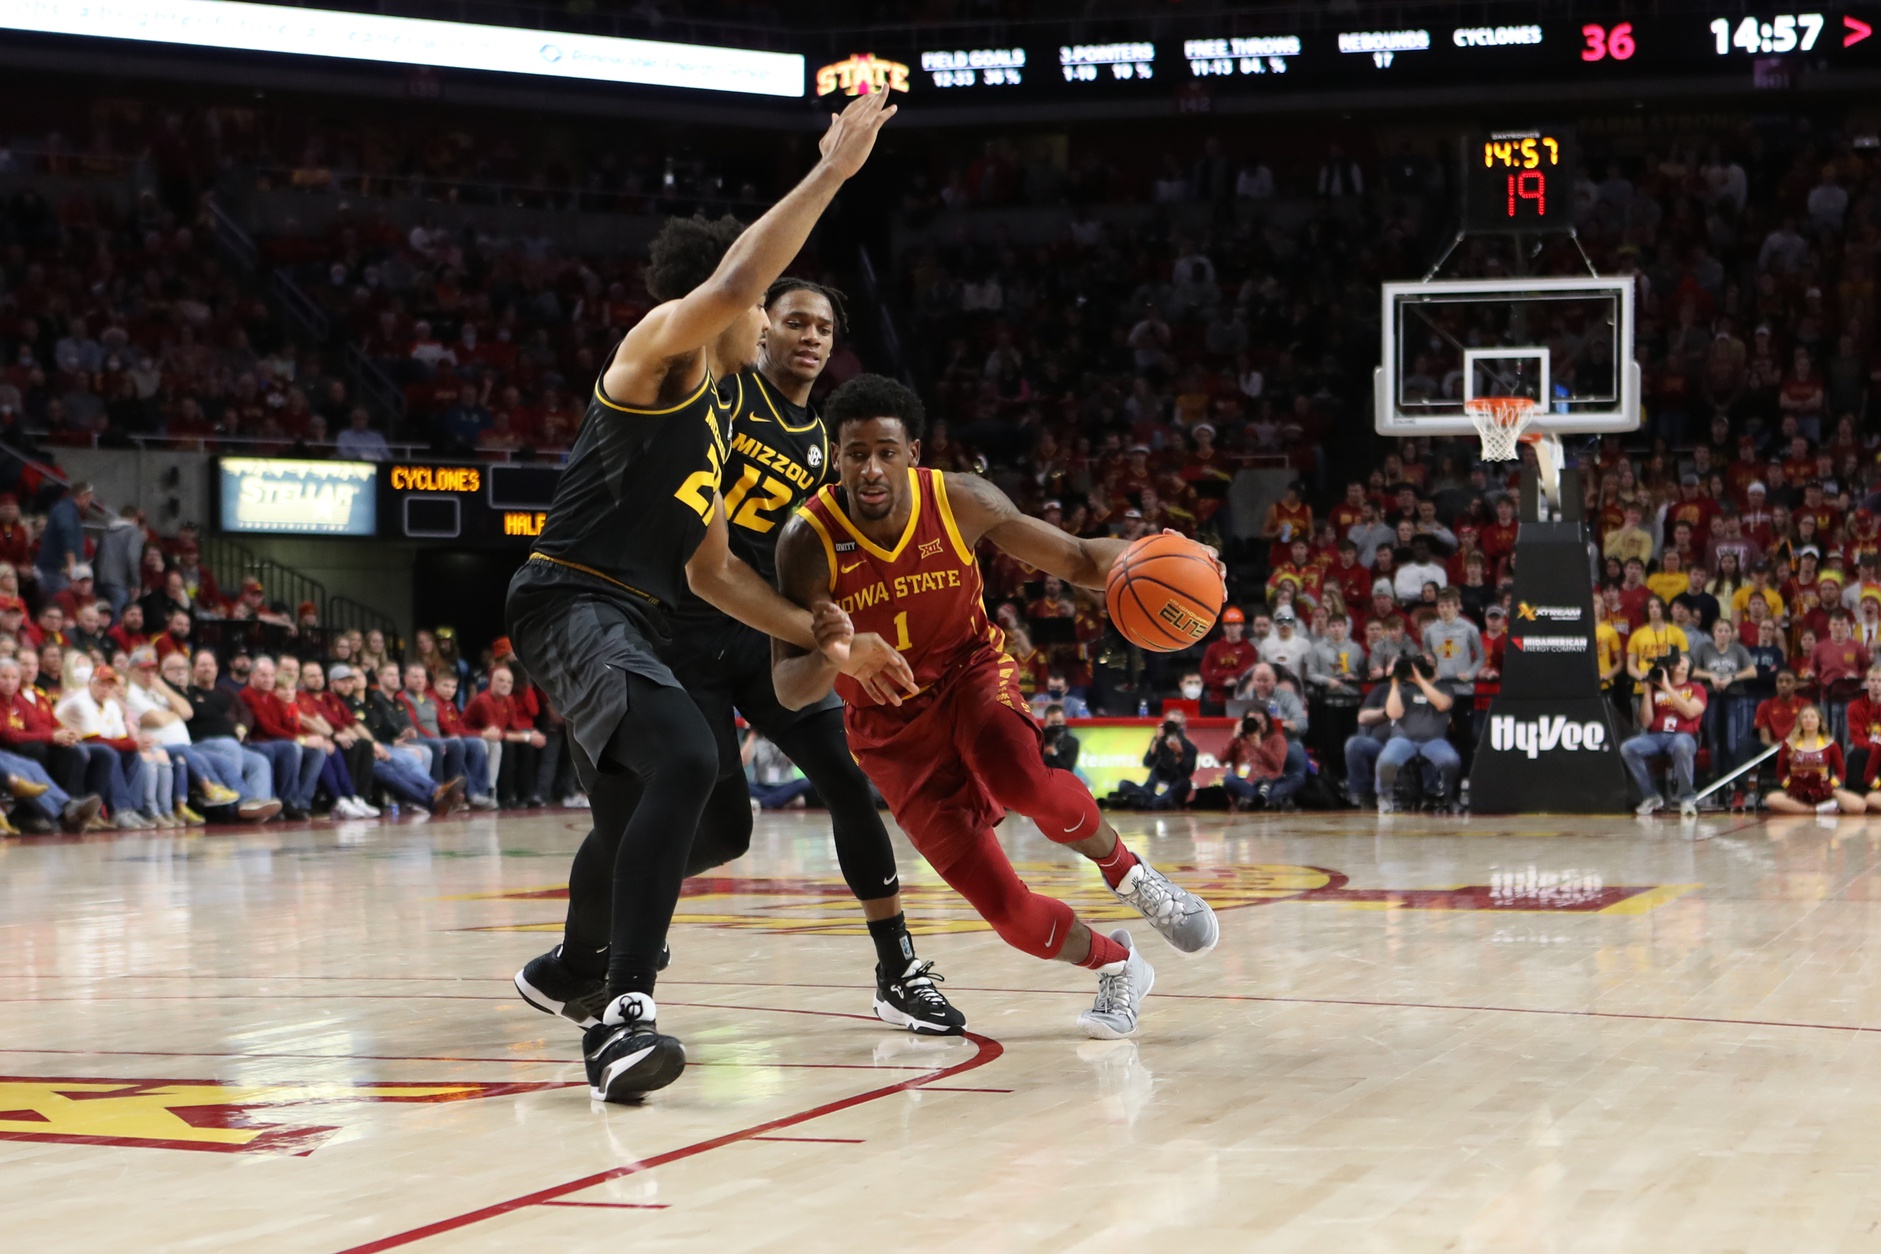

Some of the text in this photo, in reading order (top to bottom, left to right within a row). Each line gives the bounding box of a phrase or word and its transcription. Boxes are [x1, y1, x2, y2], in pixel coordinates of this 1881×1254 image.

[1184, 35, 1301, 58] FREE THROWS
[1338, 29, 1430, 50] REBOUNDS
[1453, 25, 1543, 46] CYCLONES
[1581, 22, 1635, 61] 36
[1711, 13, 1824, 54] 14:57
[921, 48, 1026, 71] FIELD GOALS
[1059, 42, 1155, 64] 3-POINTERS
[816, 57, 910, 97] STATE
[1190, 59, 1233, 77] 11-13
[1485, 137, 1558, 168] 14:57
[1507, 169, 1546, 217] 19
[731, 432, 815, 491] MIZZOU
[391, 466, 481, 492] CYCLONES
[723, 463, 793, 534] 12
[836, 542, 856, 552] UNITY
[835, 570, 961, 614] OWA STATE
[1158, 602, 1209, 639] ELITE
[1536, 606, 1582, 617] XTREAM
[894, 611, 913, 651] 1
[1522, 636, 1588, 647] MIDAMERICAN
[1080, 753, 1143, 768] teams.
